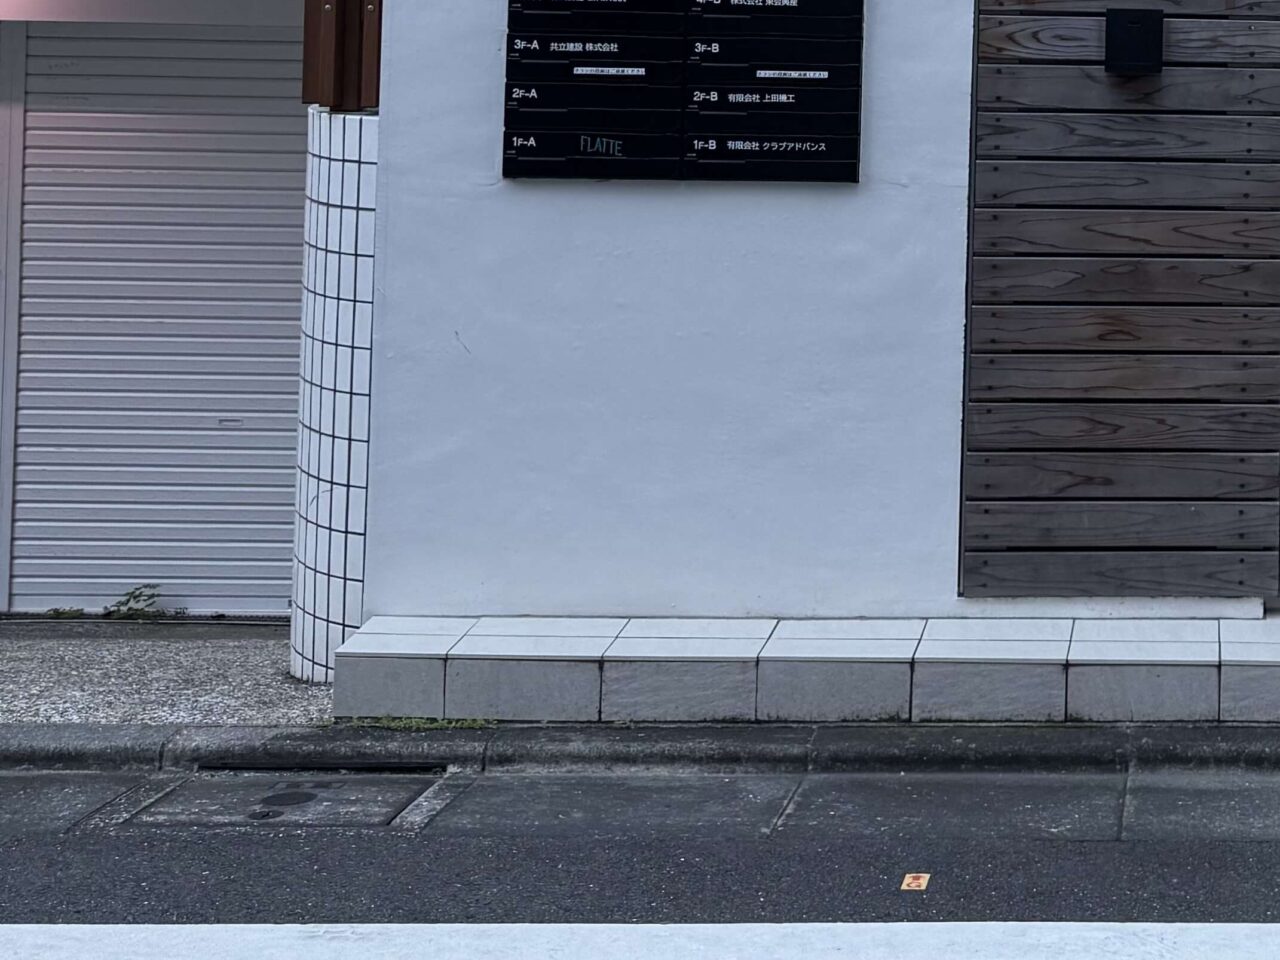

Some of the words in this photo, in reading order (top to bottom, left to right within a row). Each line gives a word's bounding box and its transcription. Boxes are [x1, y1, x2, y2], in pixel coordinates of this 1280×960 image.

[513, 39, 539, 50] 3F-A
[694, 43, 720, 53] 3F-B
[512, 88, 538, 99] 2F-A
[693, 91, 718, 101] 2F-B
[727, 93, 760, 103] 有限会社
[511, 136, 536, 147] 1F-A
[692, 140, 717, 150] 1F-B
[727, 141, 760, 151] 有限会社
[762, 142, 826, 151] クラブアドバンス
